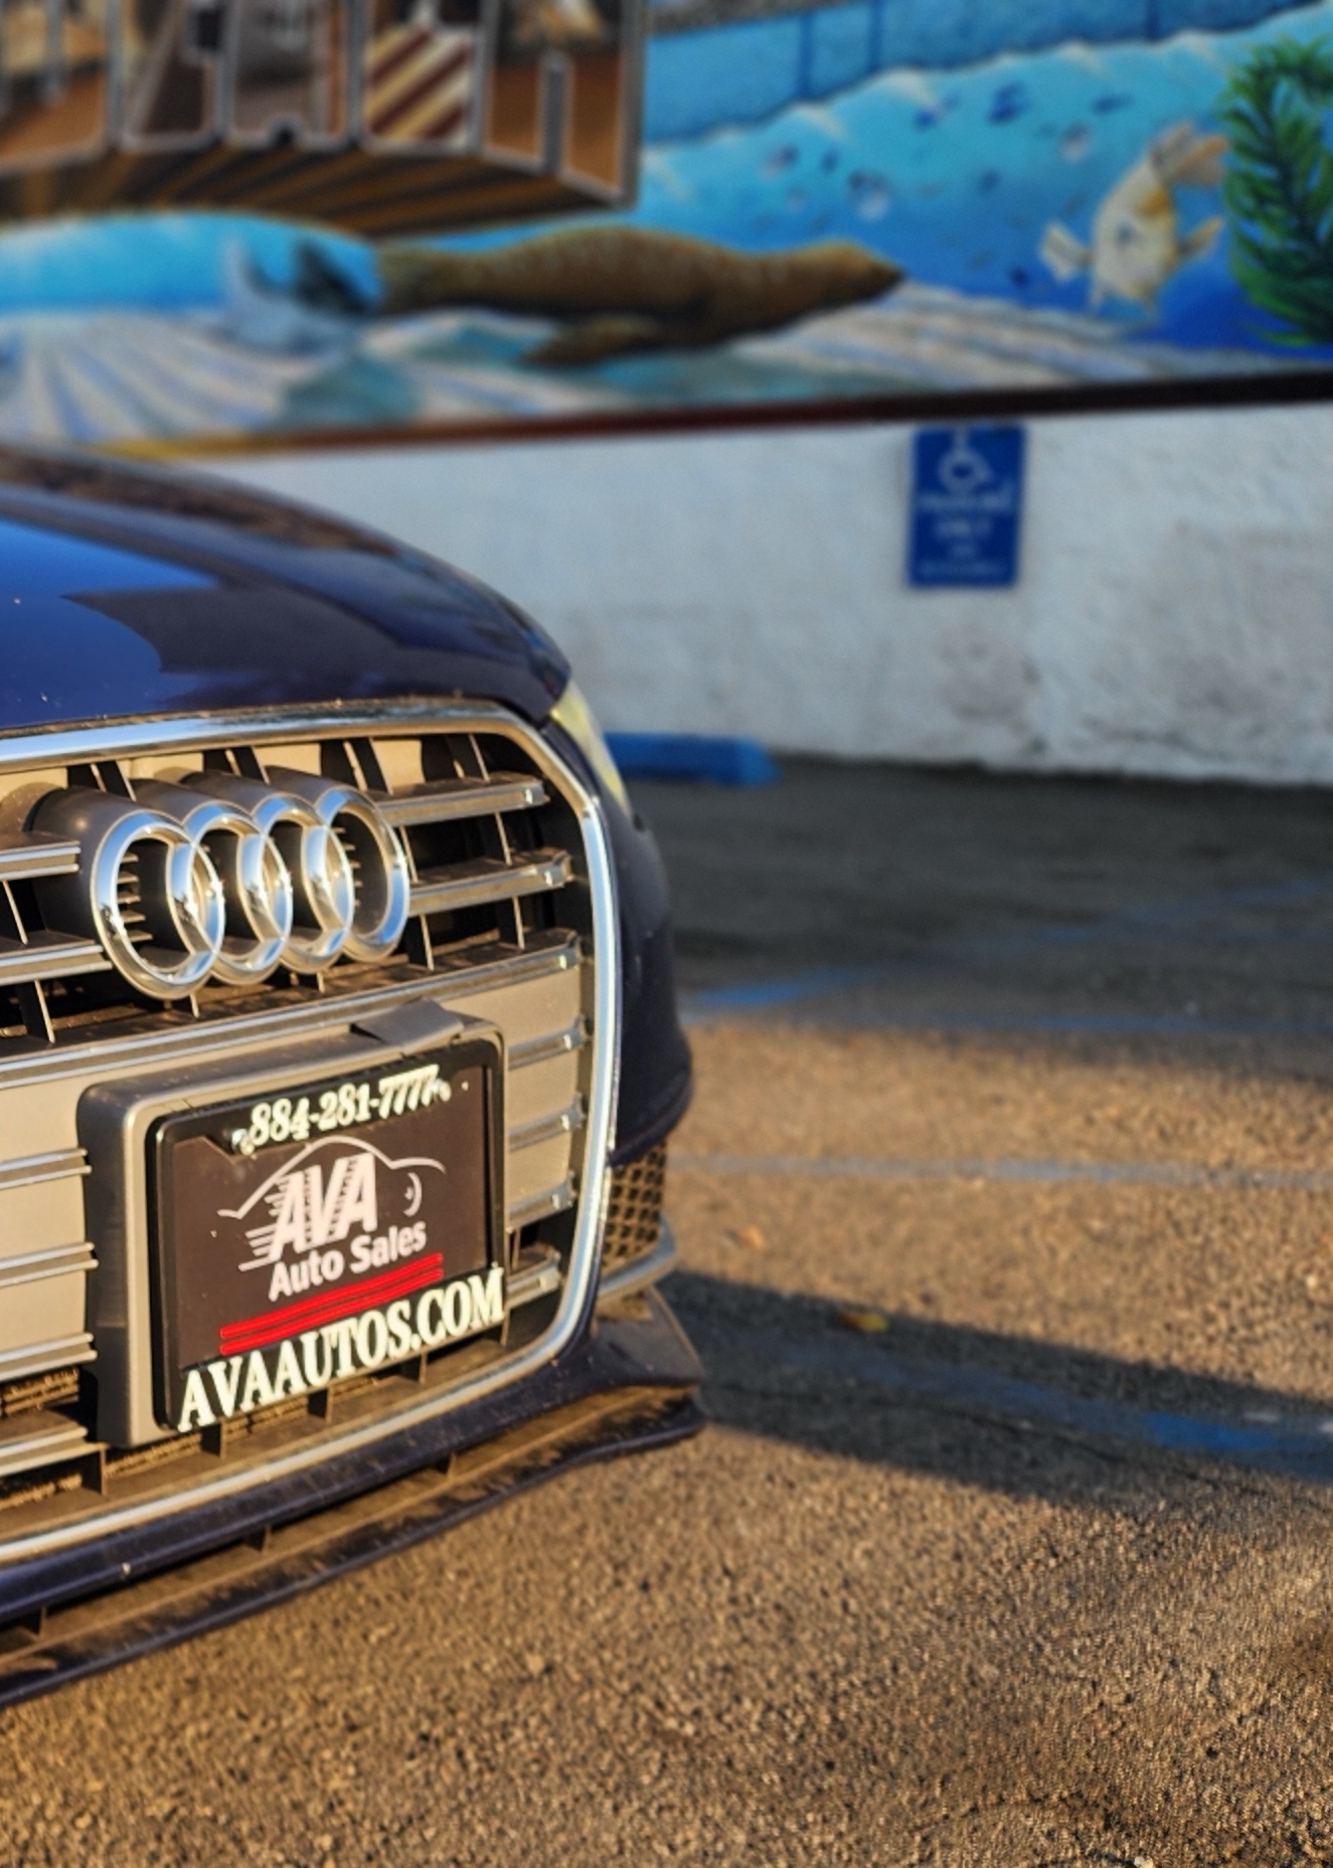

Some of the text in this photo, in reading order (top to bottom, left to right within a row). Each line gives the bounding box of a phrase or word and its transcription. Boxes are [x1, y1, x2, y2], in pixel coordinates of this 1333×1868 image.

[267, 1152, 378, 1263] AVA
[268, 1221, 428, 1302] Auto Sales
[177, 1266, 506, 1433] AVAAUTOS.COM
